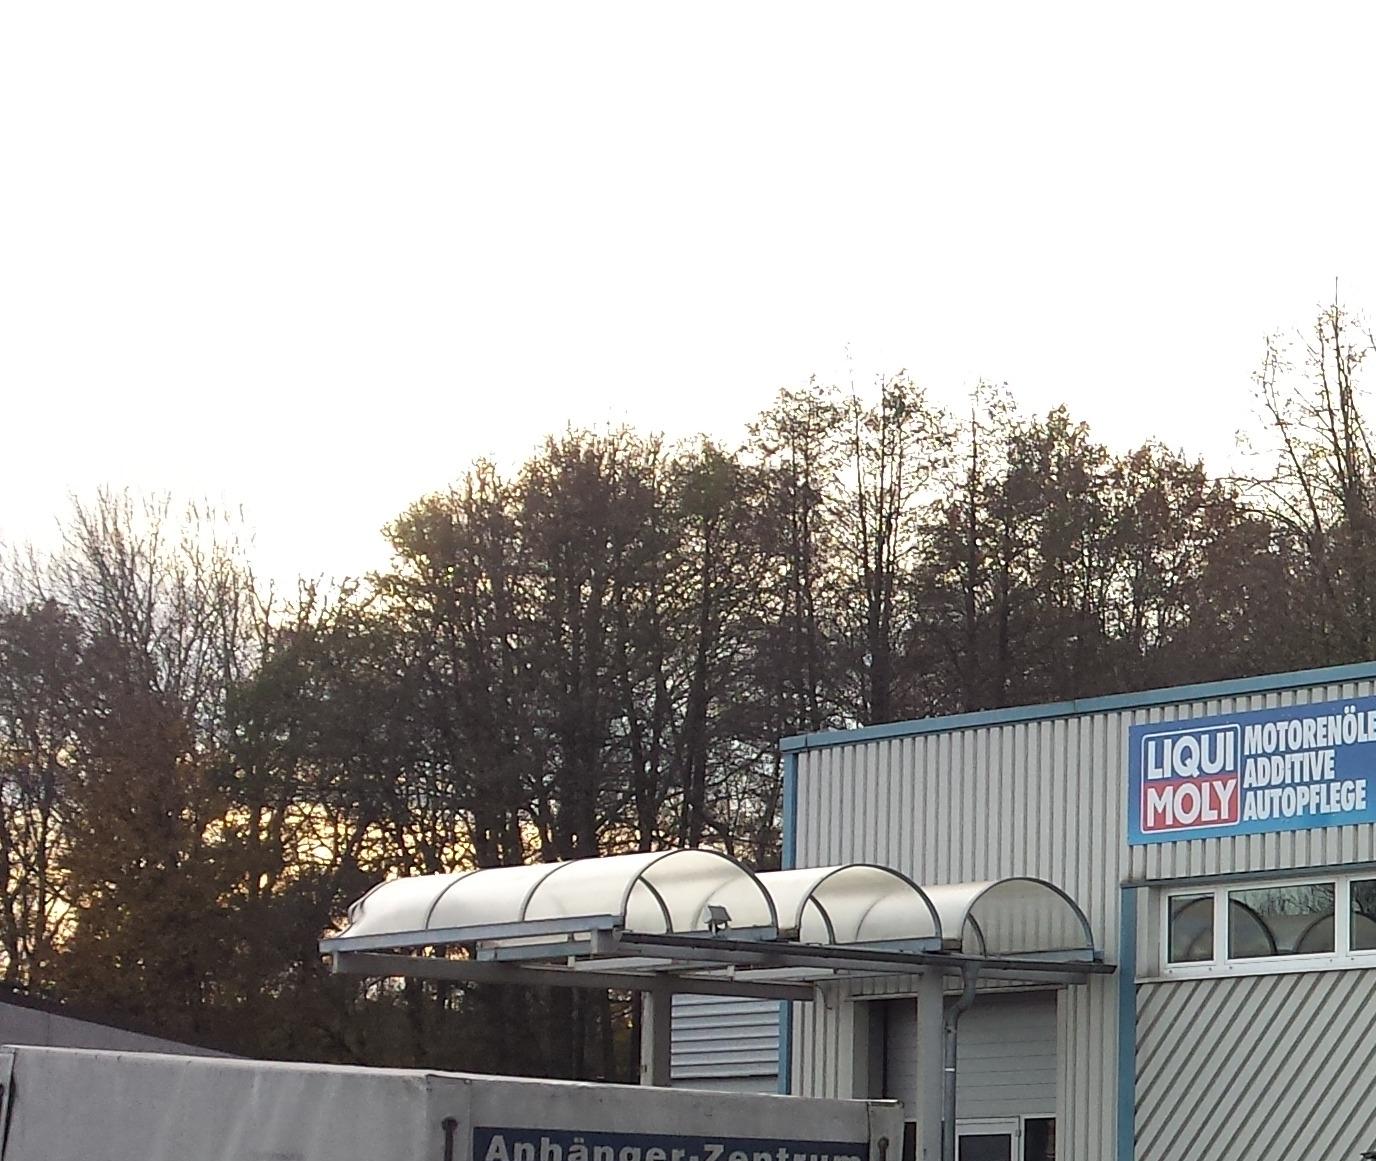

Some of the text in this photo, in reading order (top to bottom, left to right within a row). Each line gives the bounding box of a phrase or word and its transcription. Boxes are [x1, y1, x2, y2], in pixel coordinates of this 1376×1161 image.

[1147, 731, 1235, 778] LIQUI
[1243, 749, 1335, 788] ADDITIVE
[1146, 778, 1237, 827] MOLY
[1243, 779, 1367, 821] AUTOPFLEGE
